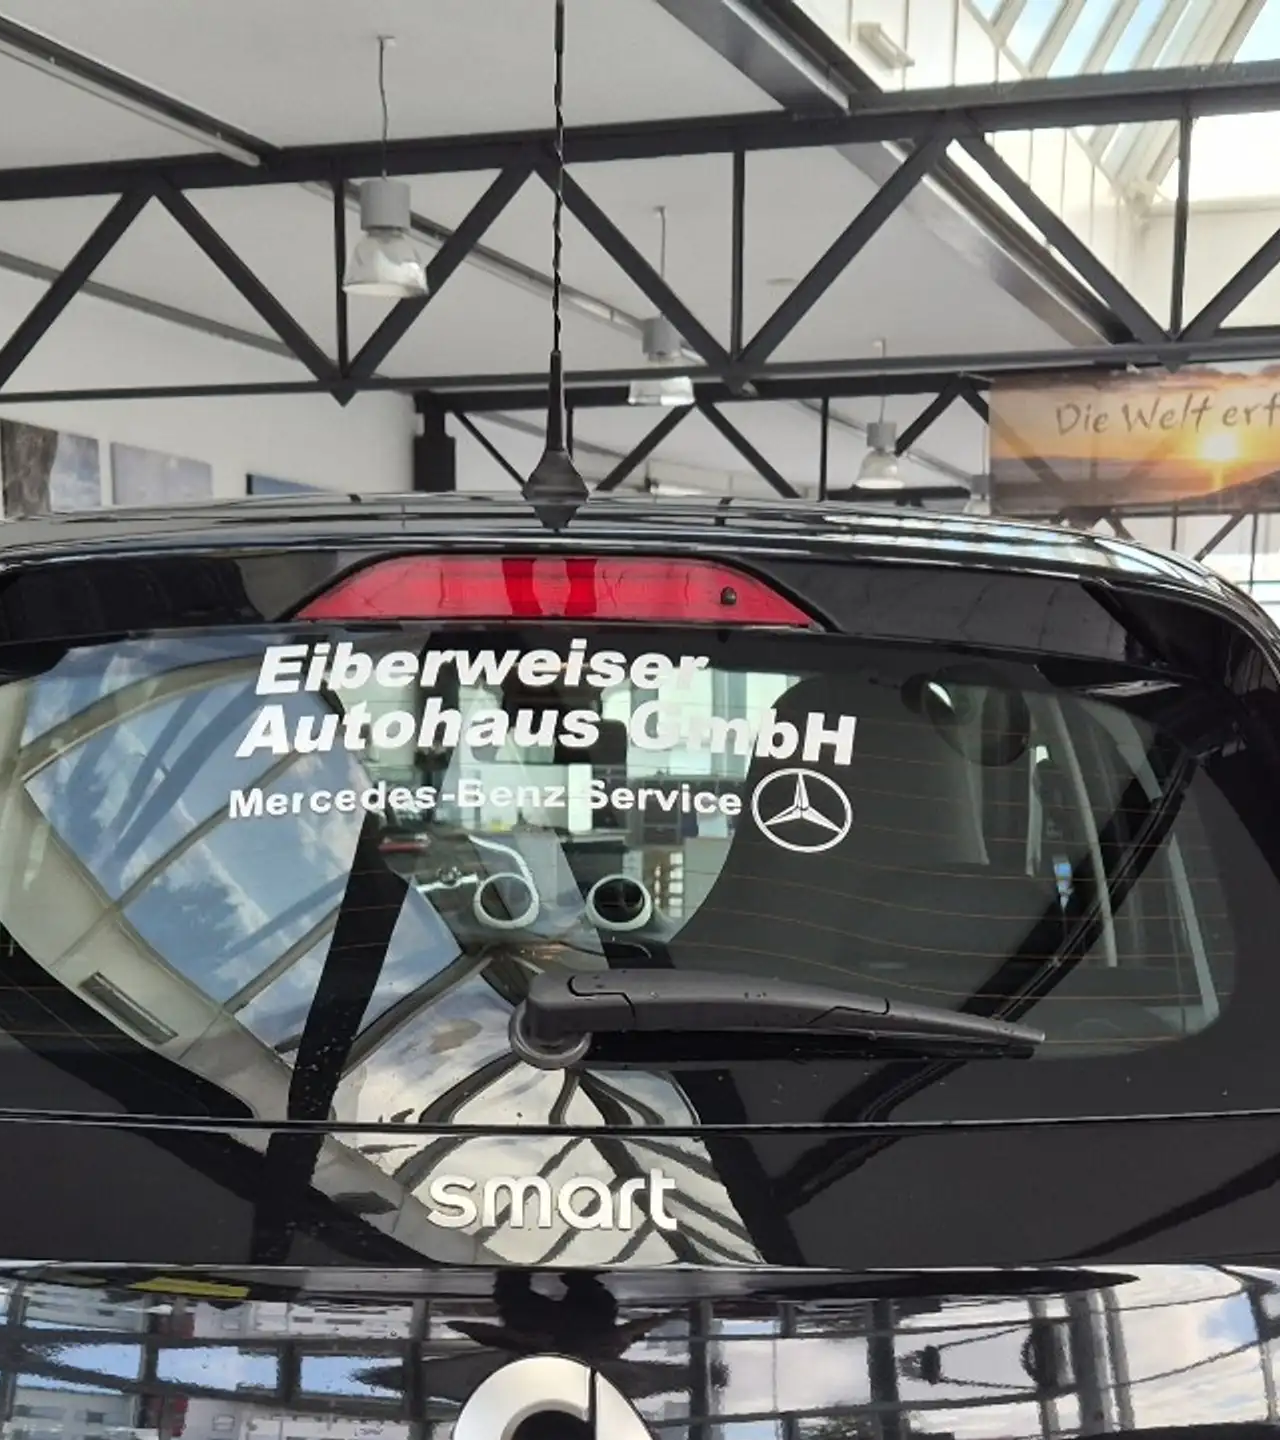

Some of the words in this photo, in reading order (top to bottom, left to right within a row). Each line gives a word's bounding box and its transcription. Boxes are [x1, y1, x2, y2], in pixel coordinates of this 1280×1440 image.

[1055, 402, 1110, 436] Die
[1122, 393, 1212, 433] Welt
[253, 638, 707, 696] Eiberweiser
[235, 698, 601, 760] Autohaus
[628, 702, 857, 766] GmbH
[228, 779, 567, 821] Mercedes-Benz
[585, 779, 743, 817] Service
[425, 1167, 678, 1231] smart
